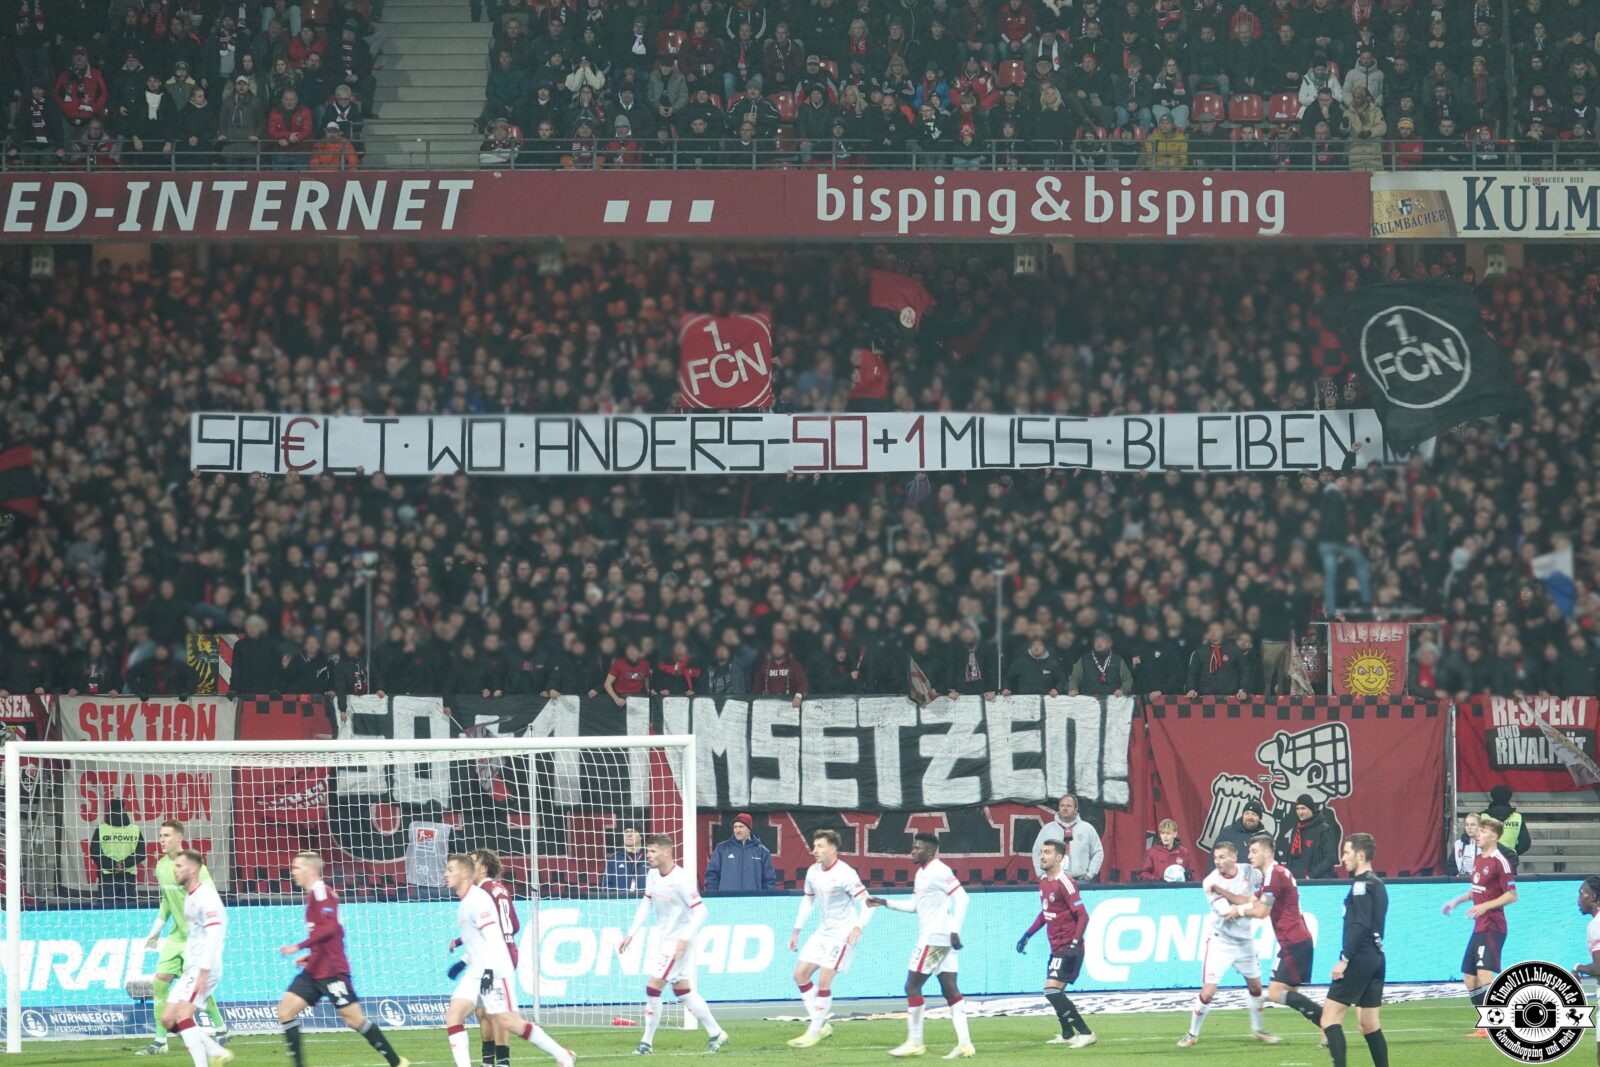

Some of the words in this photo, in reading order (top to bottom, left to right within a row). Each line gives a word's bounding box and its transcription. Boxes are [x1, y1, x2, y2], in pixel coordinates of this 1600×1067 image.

[2, 179, 475, 233] ED-INTERNET
[816, 173, 1017, 235] bisping
[1030, 175, 1073, 222] &
[1084, 175, 1287, 237] bisping
[1370, 207, 1449, 237] KULMBACHER
[1462, 176, 1600, 232] KULM
[702, 320, 732, 353] 1.
[1384, 313, 1418, 345] 1.
[686, 341, 769, 397] FCN
[1373, 337, 1465, 391] FCN
[940, 415, 1093, 470] MUSS
[78, 702, 217, 741] SEKTION
[1490, 695, 1590, 727] RESPEKT
[1495, 731, 1587, 765] RIVALIT
[1497, 724, 1520, 740] UND
[79, 770, 213, 823] STADION
[50, 1011, 124, 1025] NÜRNBERGER
[225, 1005, 314, 1020] NÜRNBEER
